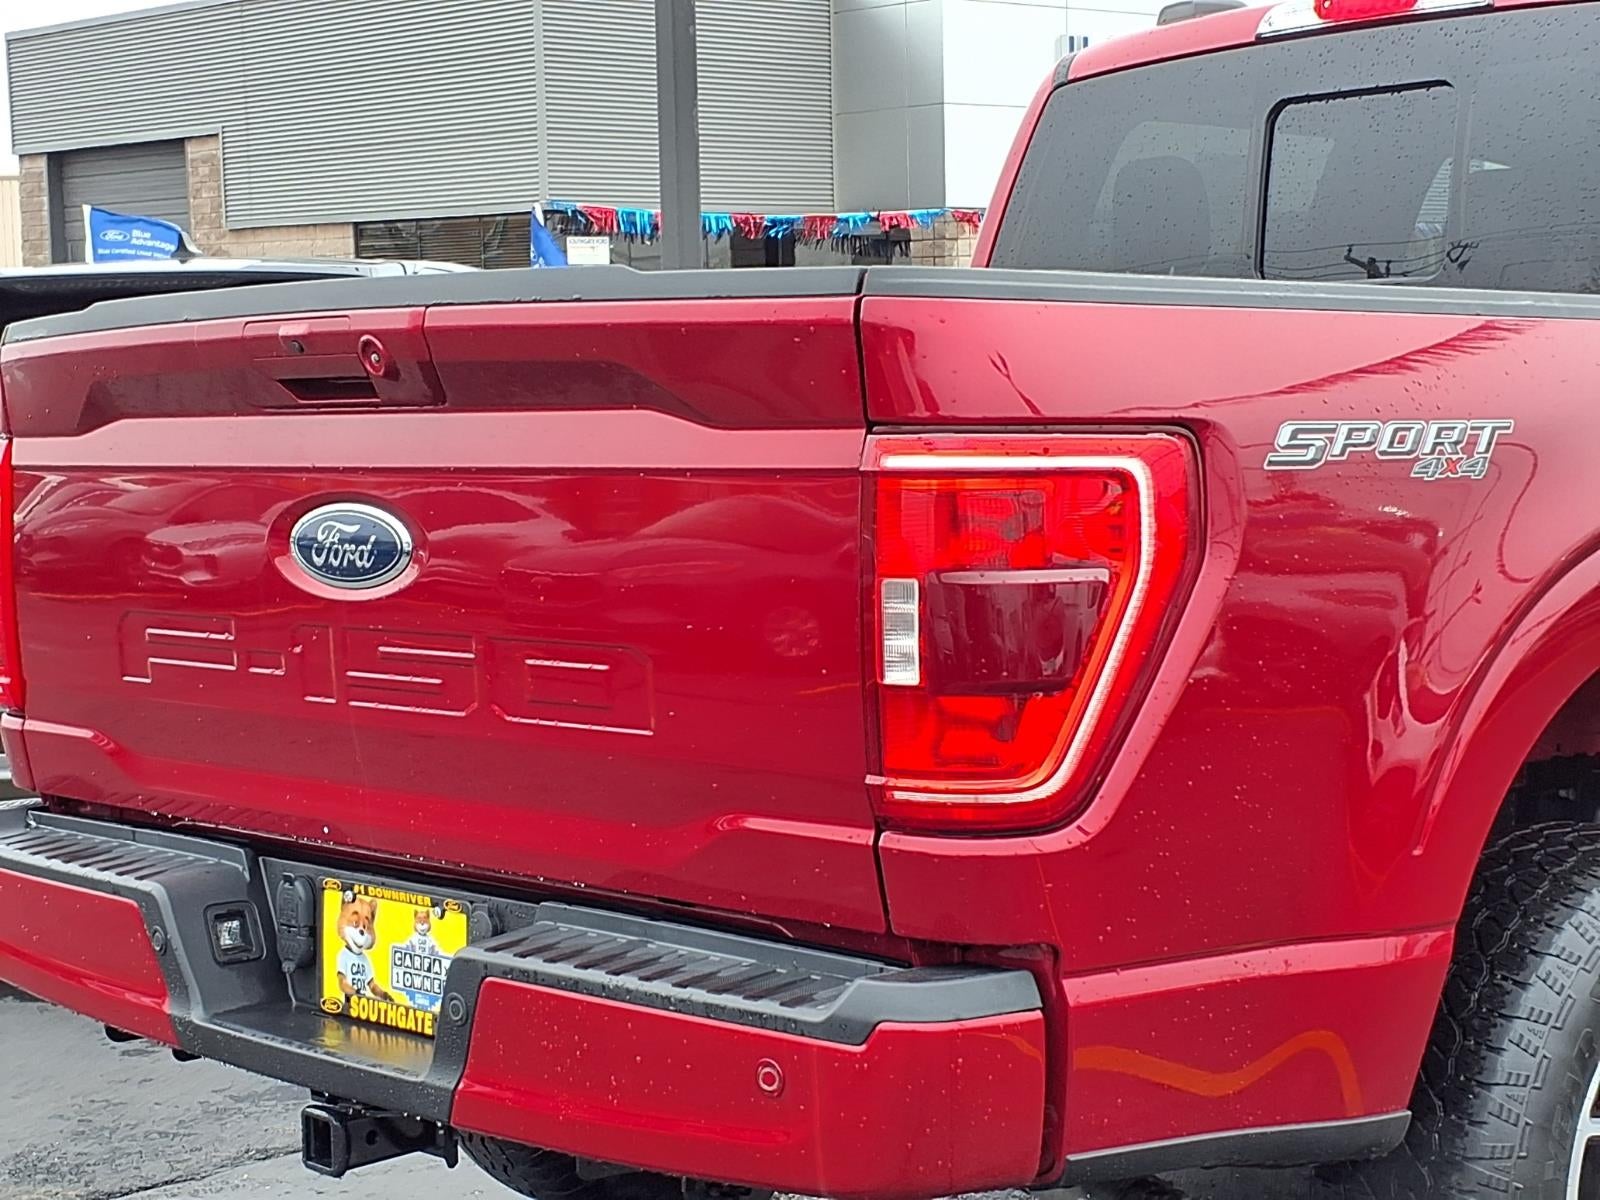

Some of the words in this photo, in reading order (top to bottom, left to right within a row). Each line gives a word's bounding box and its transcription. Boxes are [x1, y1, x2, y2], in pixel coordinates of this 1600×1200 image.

[130, 238, 176, 252] Advantage
[131, 229, 151, 239] Blue
[1264, 420, 1514, 470] SPORT
[311, 520, 377, 569] Ford
[118, 609, 656, 736] F-150
[368, 886, 432, 907] DOWNRIVER
[350, 962, 366, 976] CAR
[351, 977, 367, 992] FOX
[395, 971, 400, 984] 1
[403, 971, 447, 995] OWNE
[350, 995, 433, 1035] SOUTHGATE
